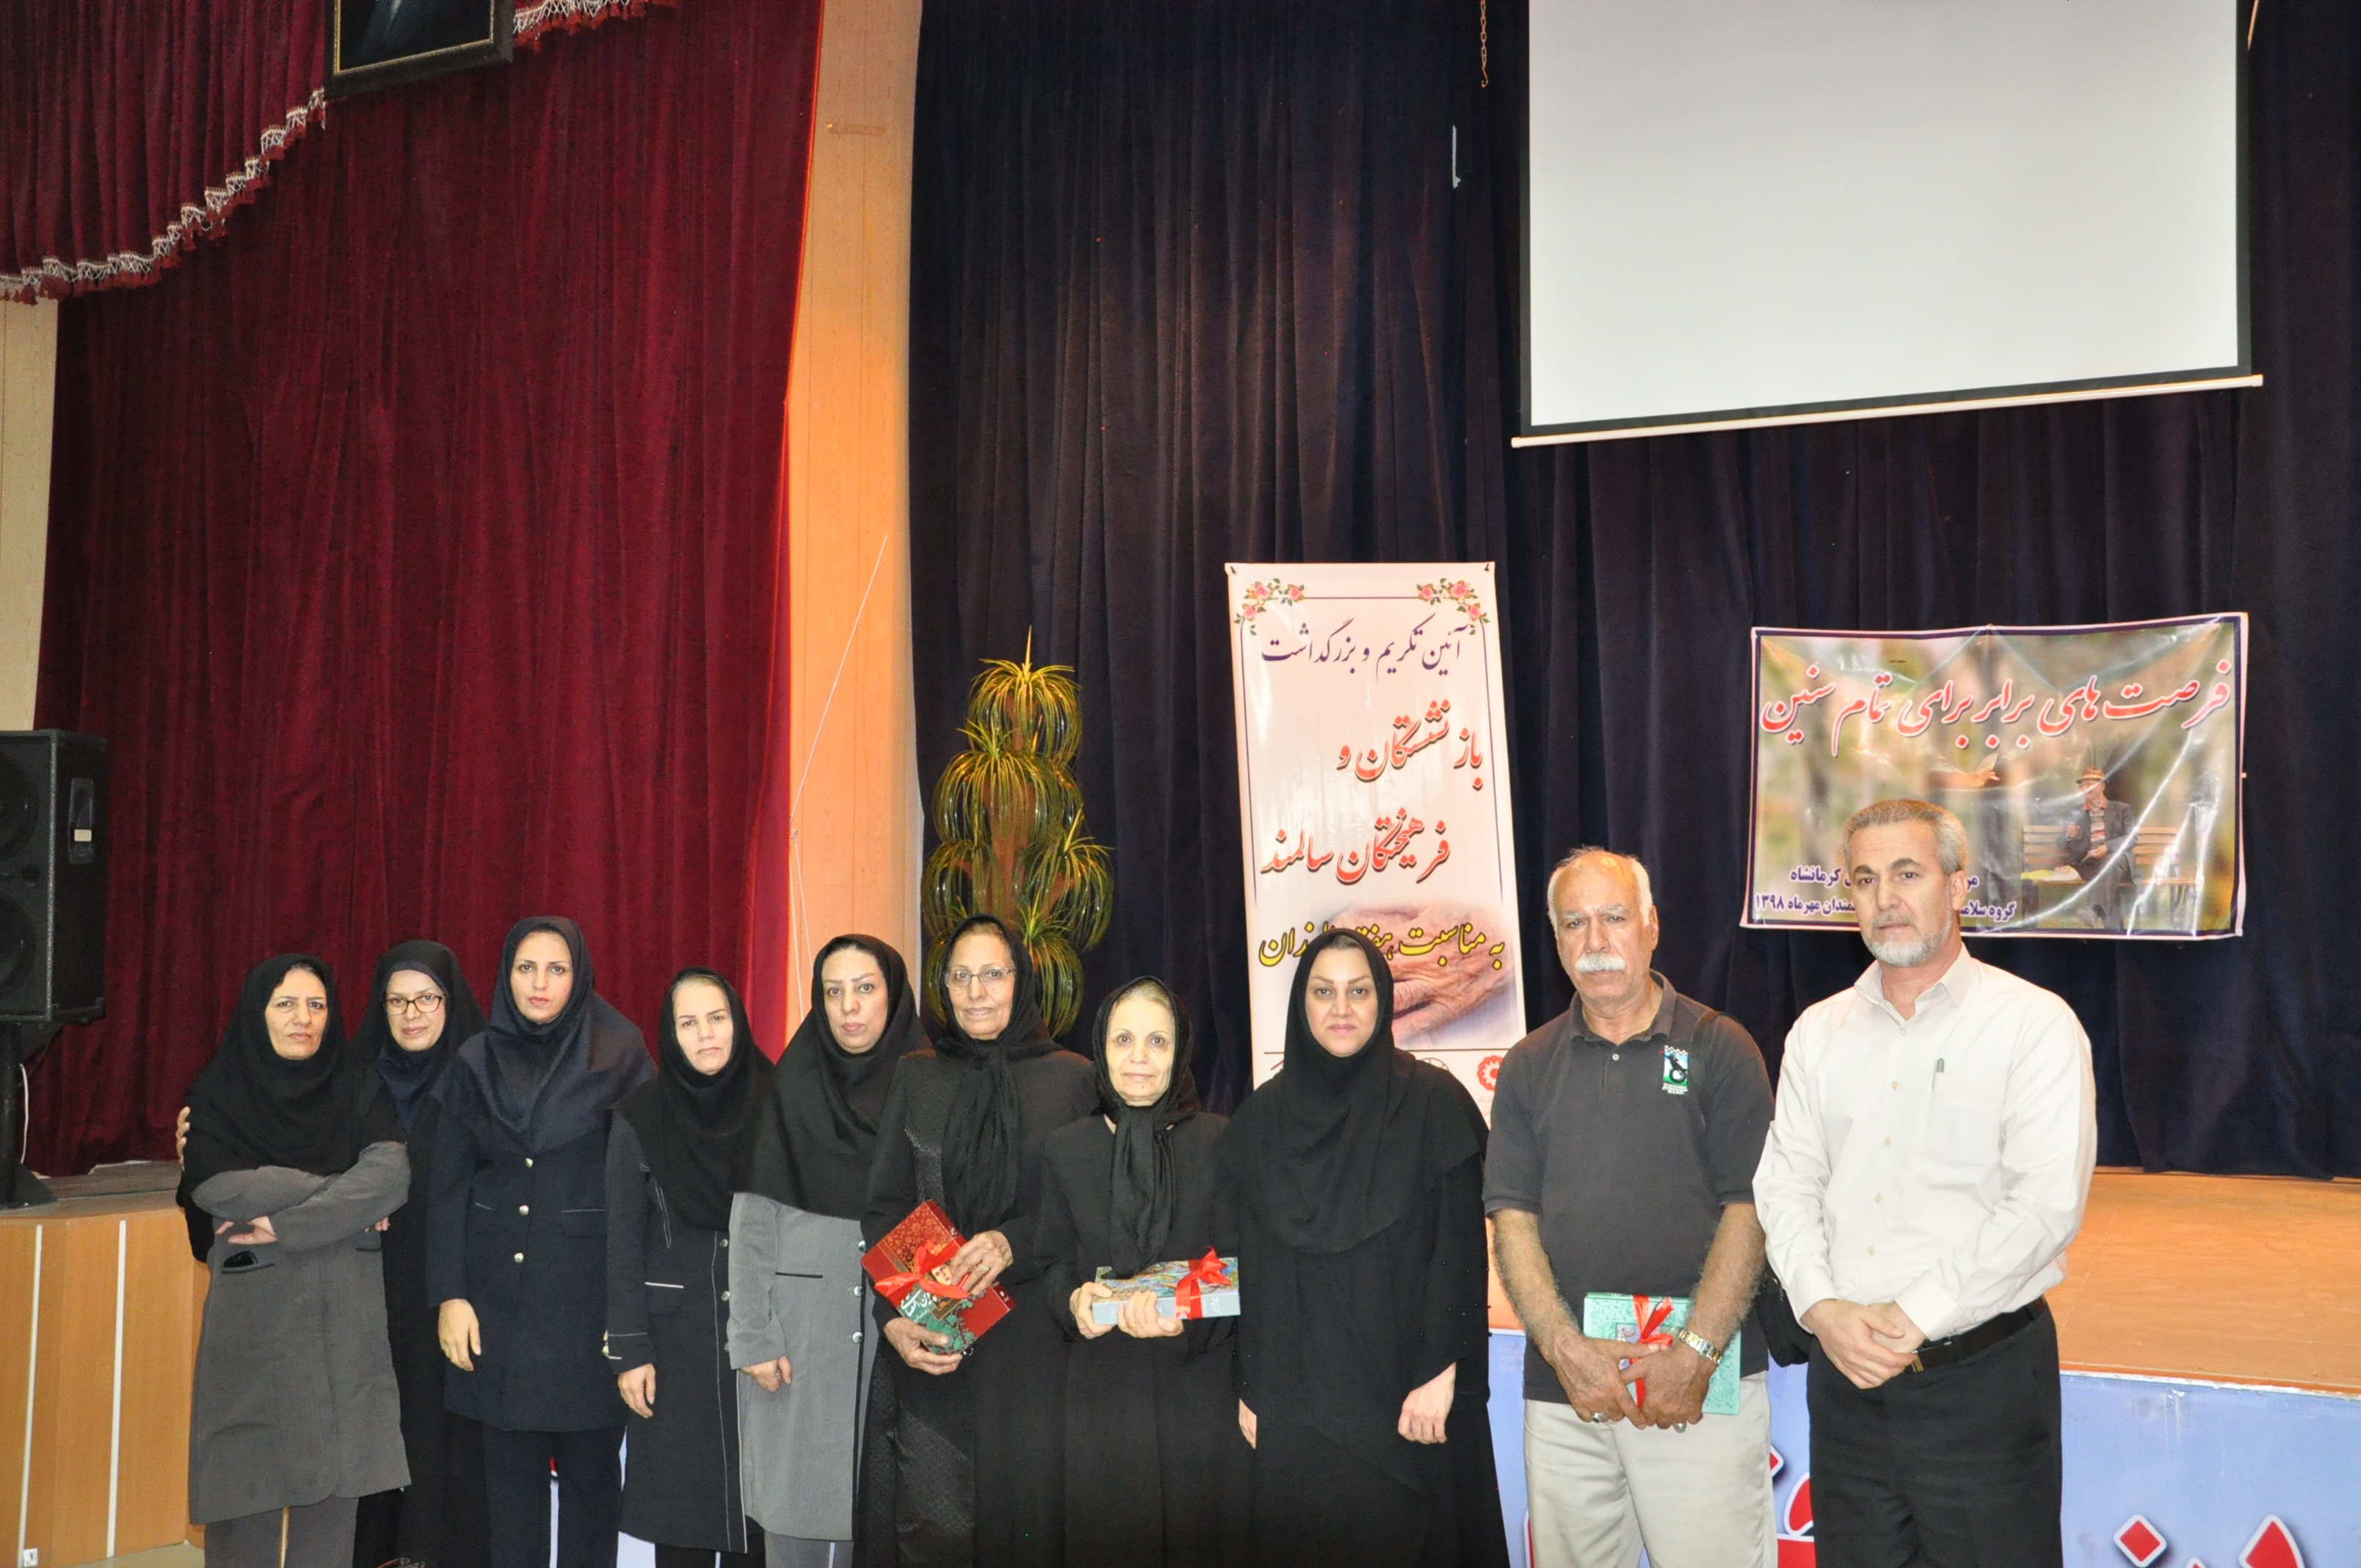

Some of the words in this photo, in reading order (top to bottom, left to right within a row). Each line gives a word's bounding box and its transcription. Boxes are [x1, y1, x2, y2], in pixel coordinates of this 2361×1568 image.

[1261, 617, 1355, 674] بزرگداشت
[1361, 647, 1371, 661] و
[1376, 612, 1436, 681] تکریم
[1760, 664, 1836, 745] سنین
[1832, 672, 1893, 757] تمام
[1897, 680, 1974, 749] برای
[1970, 678, 2035, 749] برابر
[2103, 659, 2232, 729] فرصت
[1337, 744, 1352, 771] و
[1261, 827, 1334, 874] سالمند
[1336, 807, 1451, 885] فرهیختگان
[1755, 894, 1785, 910] ۱۳۹۸
[1791, 865, 1841, 886] کرمانشاه
[1399, 922, 1487, 967] مناسبت
[1489, 941, 1506, 970] به
